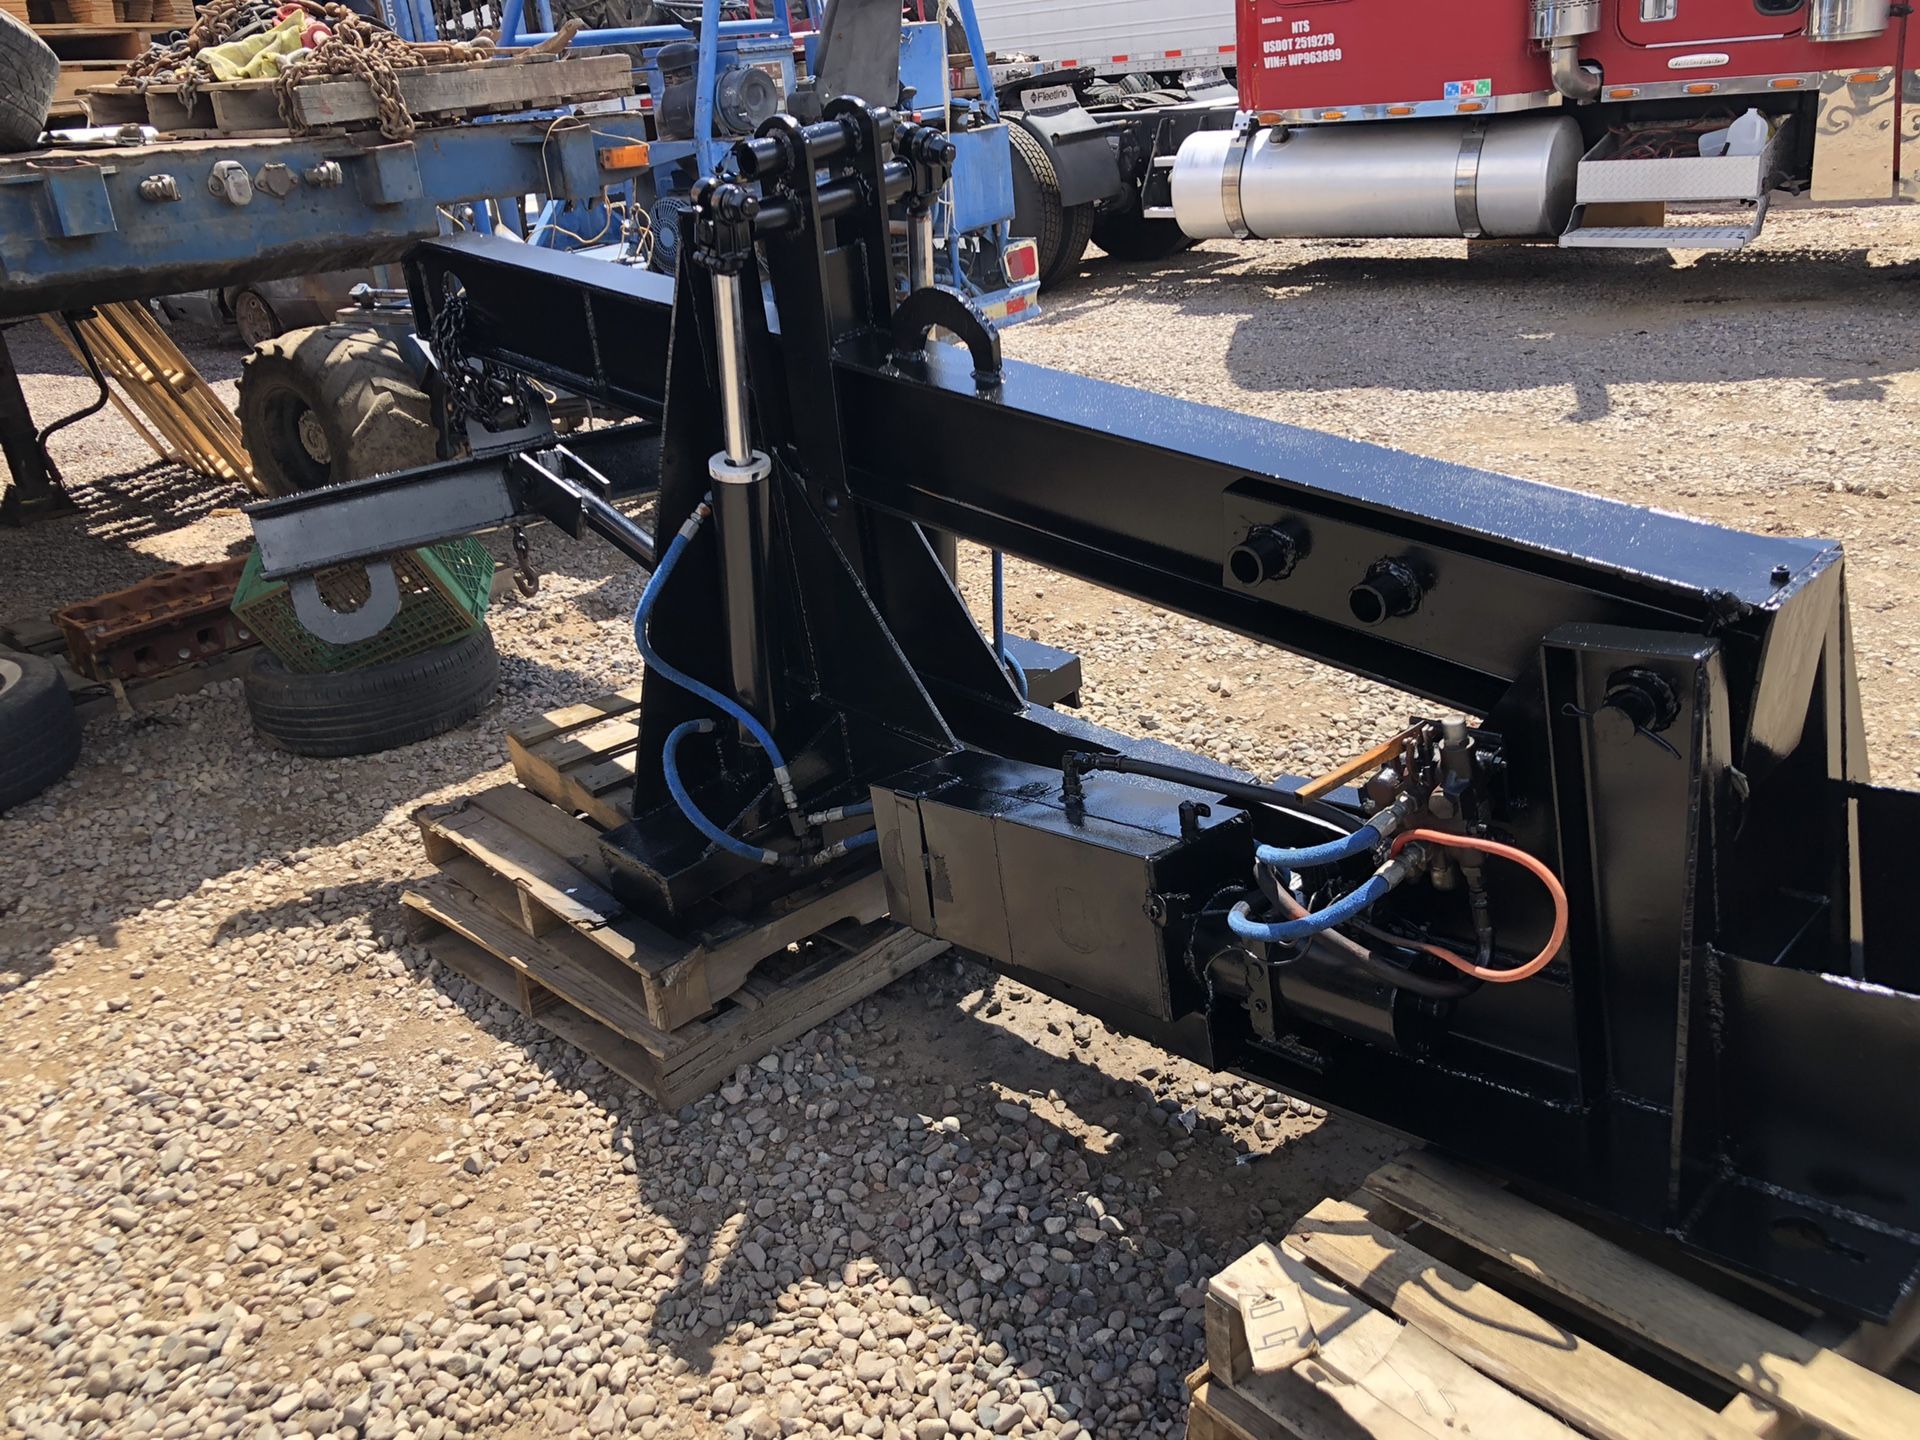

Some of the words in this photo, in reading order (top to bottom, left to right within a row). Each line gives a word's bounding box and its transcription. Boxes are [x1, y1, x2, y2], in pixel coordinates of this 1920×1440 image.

[1291, 20, 1310, 34] NTS
[1263, 38, 1294, 53] USDOT
[1295, 33, 1335, 49] 2519279
[1263, 55, 1287, 69] VIN#
[1288, 48, 1342, 66] WP963899
[1037, 90, 1068, 102] Fleetline
